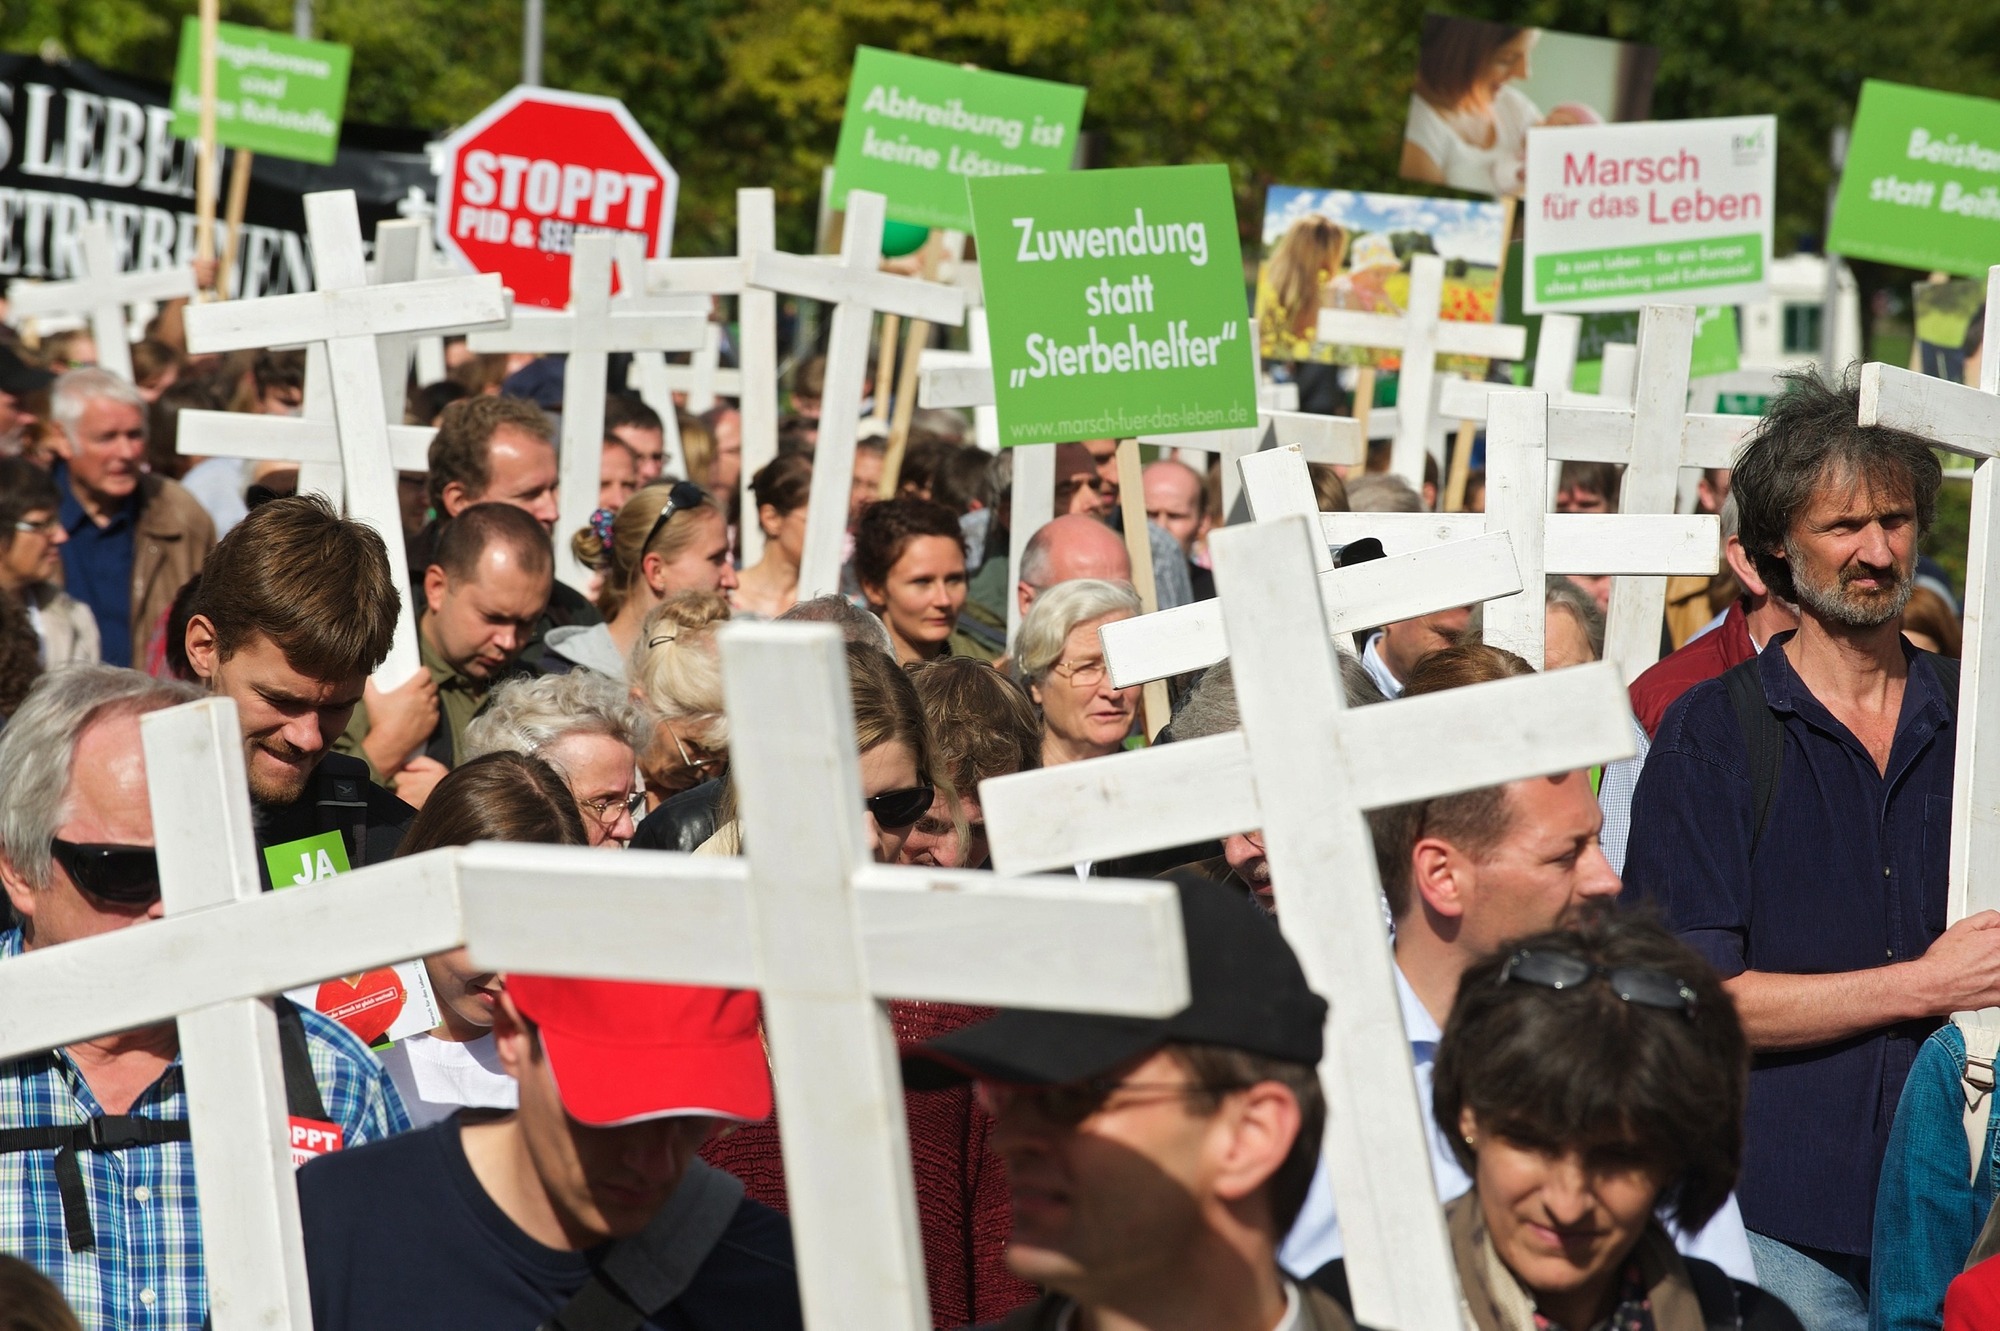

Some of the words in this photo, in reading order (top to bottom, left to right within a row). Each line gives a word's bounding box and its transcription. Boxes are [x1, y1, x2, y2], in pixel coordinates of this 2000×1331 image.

[863, 85, 1023, 148] Abtreibung
[1030, 115, 1064, 148] ist
[862, 127, 941, 169] keine
[1564, 148, 1699, 186] Marsch
[462, 149, 657, 229] STOPPT
[1542, 193, 1580, 220] für
[1588, 193, 1639, 219] das
[1649, 188, 1761, 224] Leben
[1870, 176, 1934, 208] statt
[456, 205, 511, 244] PID
[510, 218, 535, 248] &
[1012, 207, 1208, 266] Zuwendung
[1085, 274, 1154, 316] statt
[1010, 319, 1237, 388] „Sterbehelfer“
[1010, 402, 1248, 437] www.marsch-fuer-das-leben.de
[293, 848, 338, 885] JA
